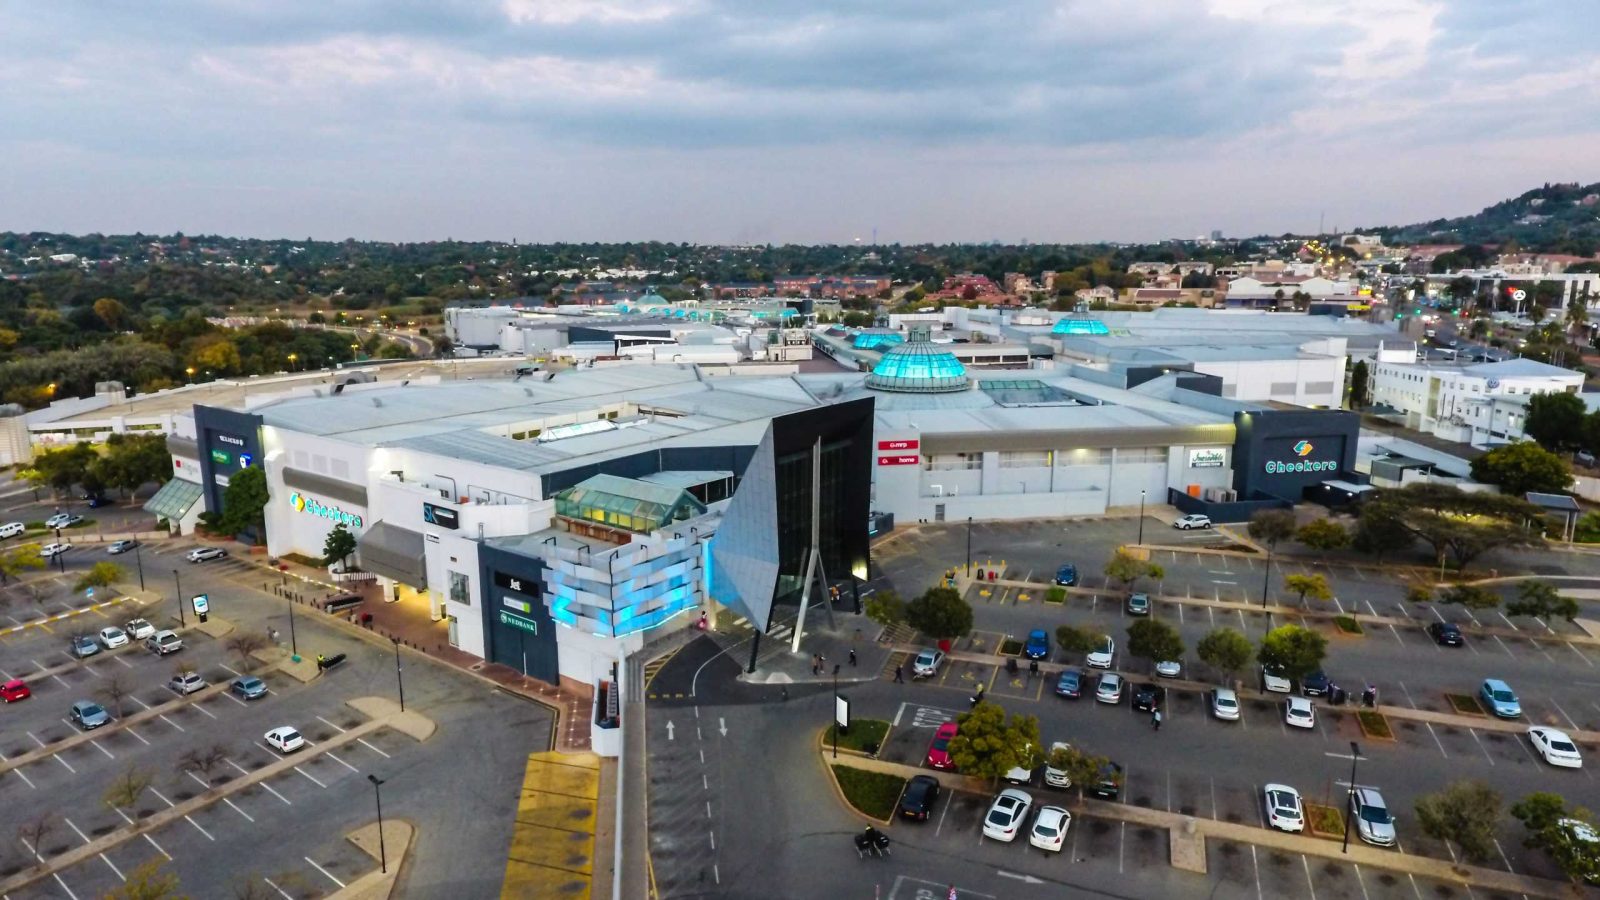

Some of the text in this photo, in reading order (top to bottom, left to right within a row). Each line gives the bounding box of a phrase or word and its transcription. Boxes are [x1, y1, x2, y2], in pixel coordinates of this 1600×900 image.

[1265, 460, 1337, 474] Checkers
[304, 498, 363, 528] Checkers
[509, 578, 522, 591] Jet
[508, 617, 534, 631] NEDBANK
